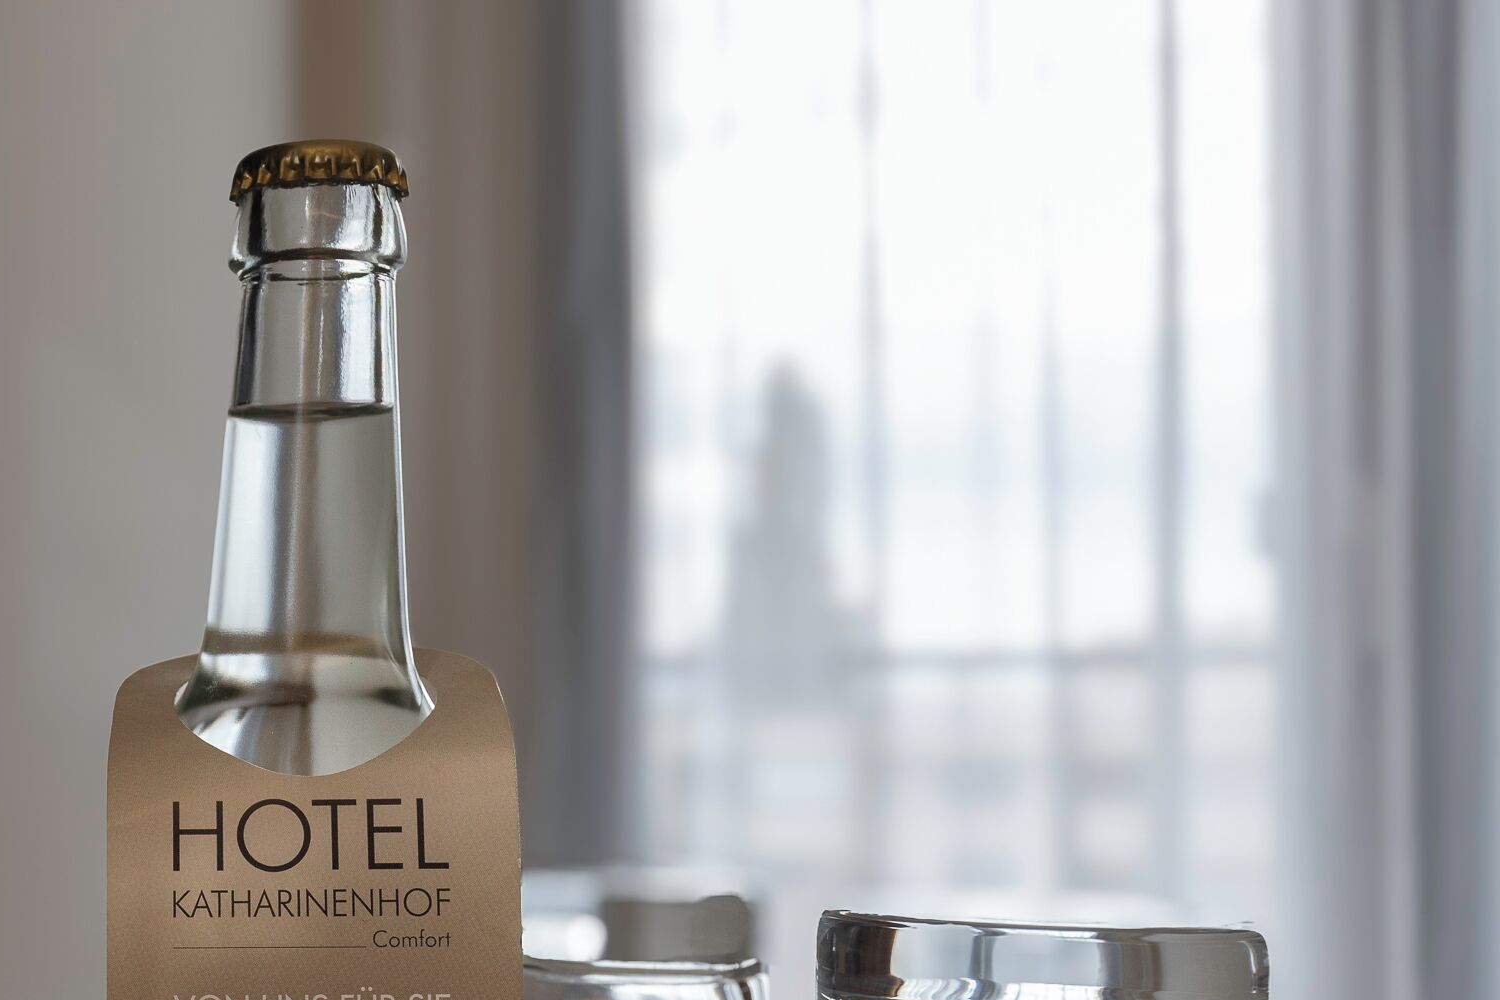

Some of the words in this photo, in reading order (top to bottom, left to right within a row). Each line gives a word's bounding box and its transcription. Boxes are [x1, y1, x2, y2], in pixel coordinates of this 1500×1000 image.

[172, 797, 450, 873] HOTEL
[172, 887, 450, 918] KATHARINENHOF
[372, 928, 451, 948] Comfort
